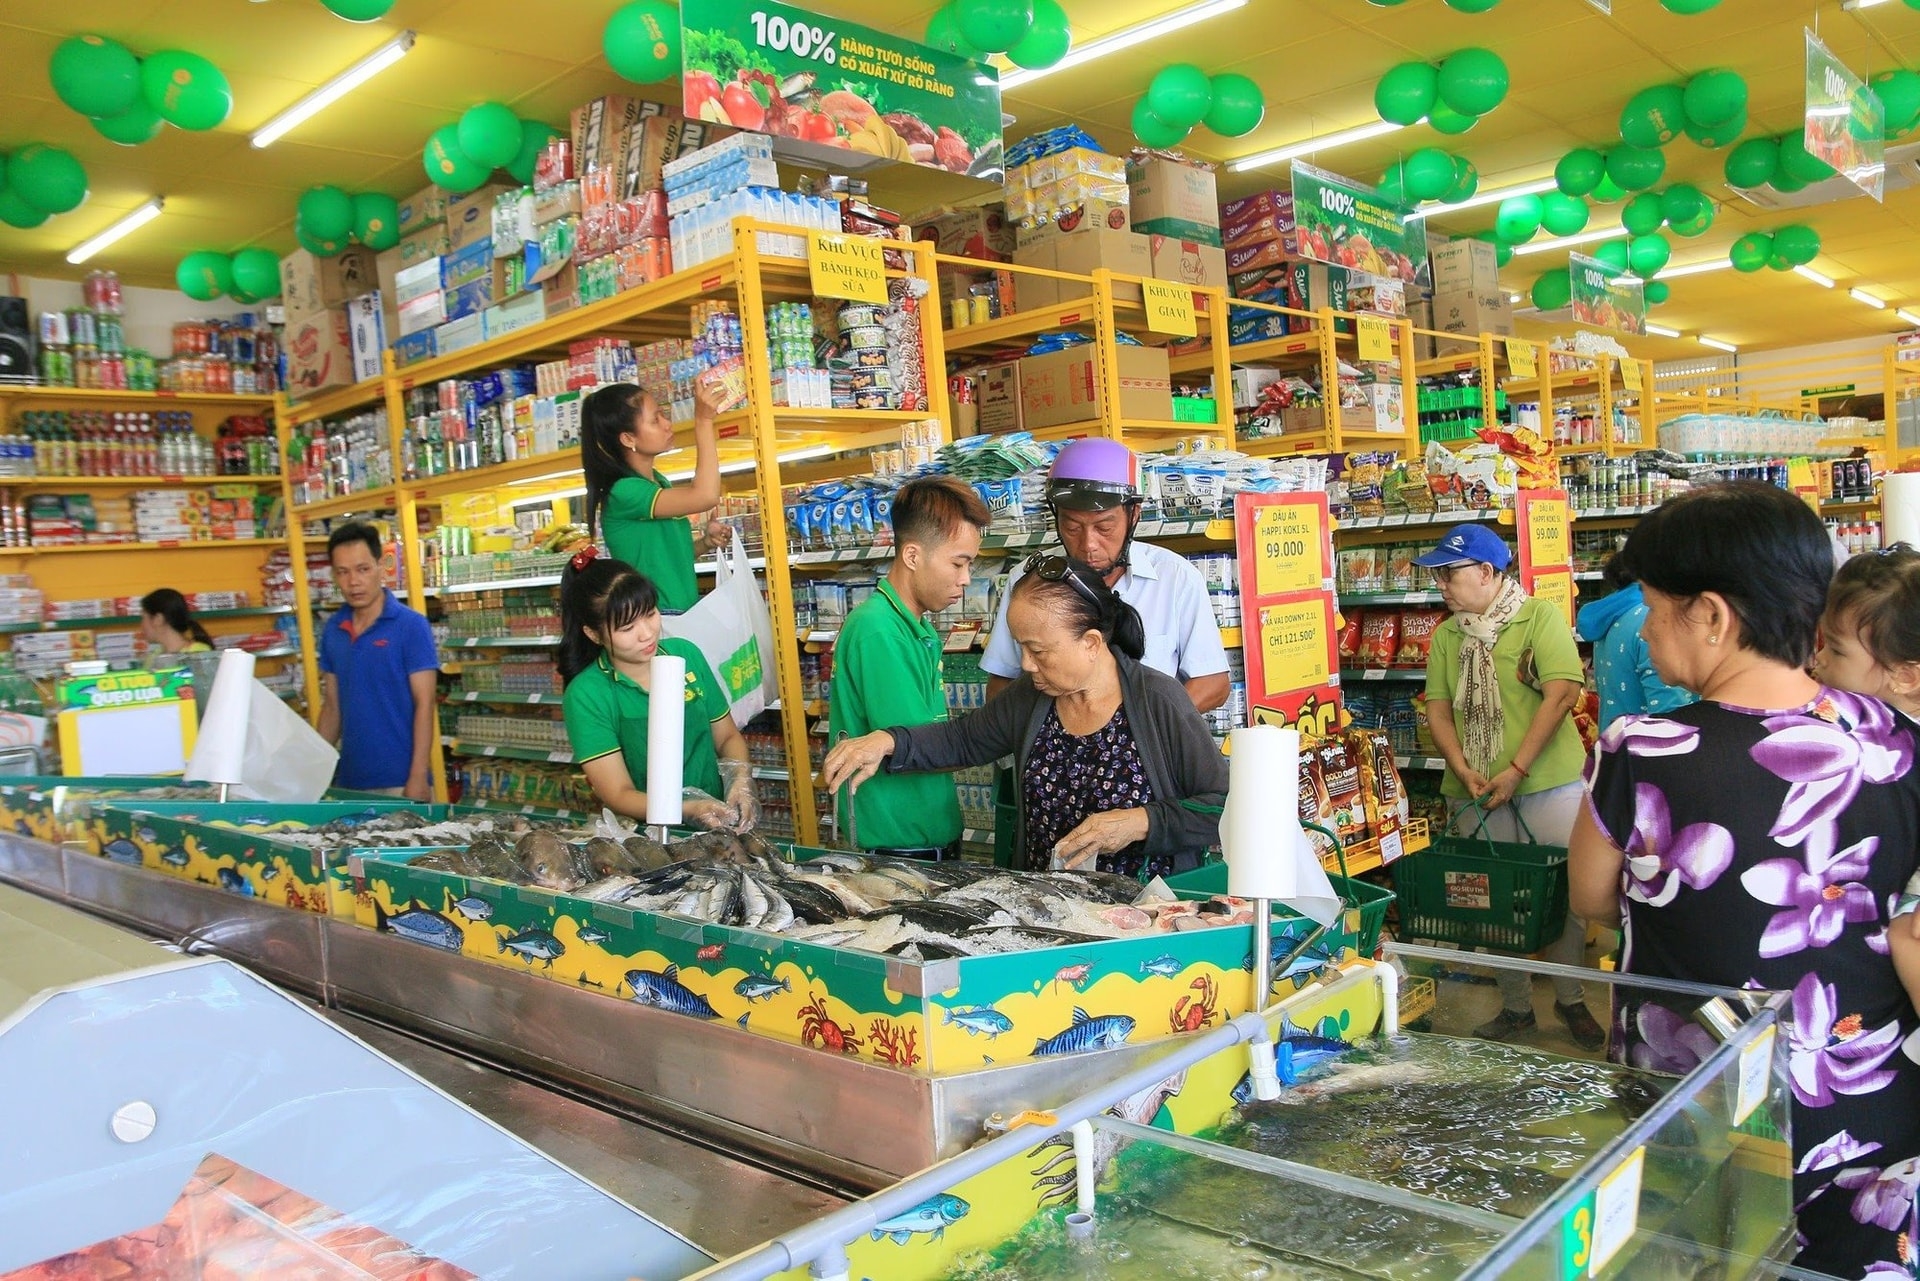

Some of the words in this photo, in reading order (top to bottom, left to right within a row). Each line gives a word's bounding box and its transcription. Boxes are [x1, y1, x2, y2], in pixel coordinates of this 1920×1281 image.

[751, 11, 836, 64] 100%
[840, 37, 875, 59] HÀNG
[876, 47, 902, 67] TƯƠI
[904, 54, 935, 76] SỐNG
[840, 55, 857, 71] CÓ
[859, 59, 889, 79] XUẤT
[890, 68, 907, 85] XỨ
[908, 73, 923, 90] RÕ
[925, 79, 954, 98] RÀNG
[1824, 66, 1847, 106] 100%
[1319, 187, 1355, 218] 100%
[817, 238, 848, 254] KHU
[851, 244, 880, 261] VỰC
[820, 260, 852, 276] BÁNH
[1149, 286, 1168, 298] KHU
[1158, 306, 1176, 318] GIA
[988, 491, 1010, 510] Star
[1262, 526, 1282, 536] HAPPI
[1283, 525, 1300, 536] KOKI
[1284, 613, 1305, 623] DOWNY
[1402, 615, 1436, 626] Snack
[1380, 818, 1395, 834] SALE
[1573, 1207, 1591, 1268] 3
